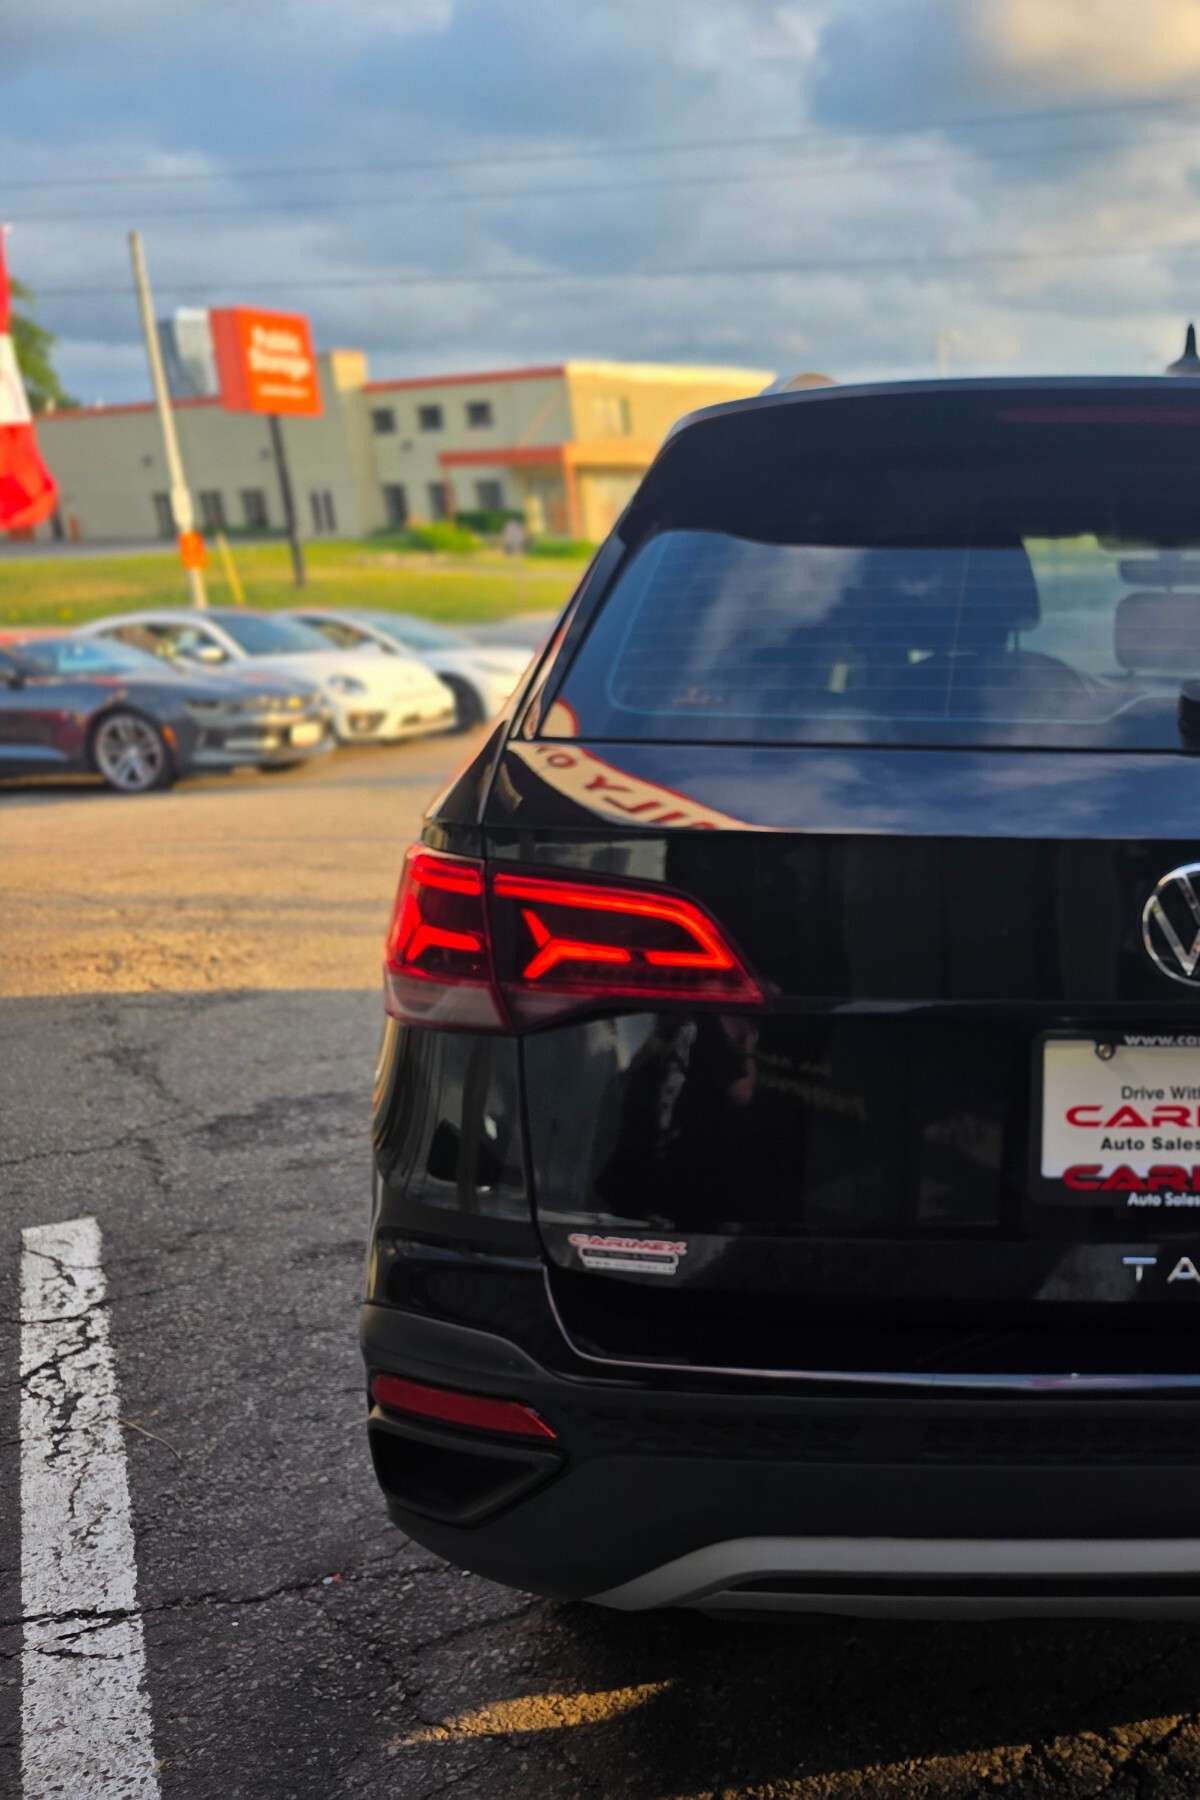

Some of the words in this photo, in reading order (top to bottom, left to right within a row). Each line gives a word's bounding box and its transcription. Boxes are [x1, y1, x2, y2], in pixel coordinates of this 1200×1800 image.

[1121, 1086, 1165, 1100] Drive
[1101, 1137, 1145, 1151] Auto
[1127, 1192, 1162, 1206] Auto
